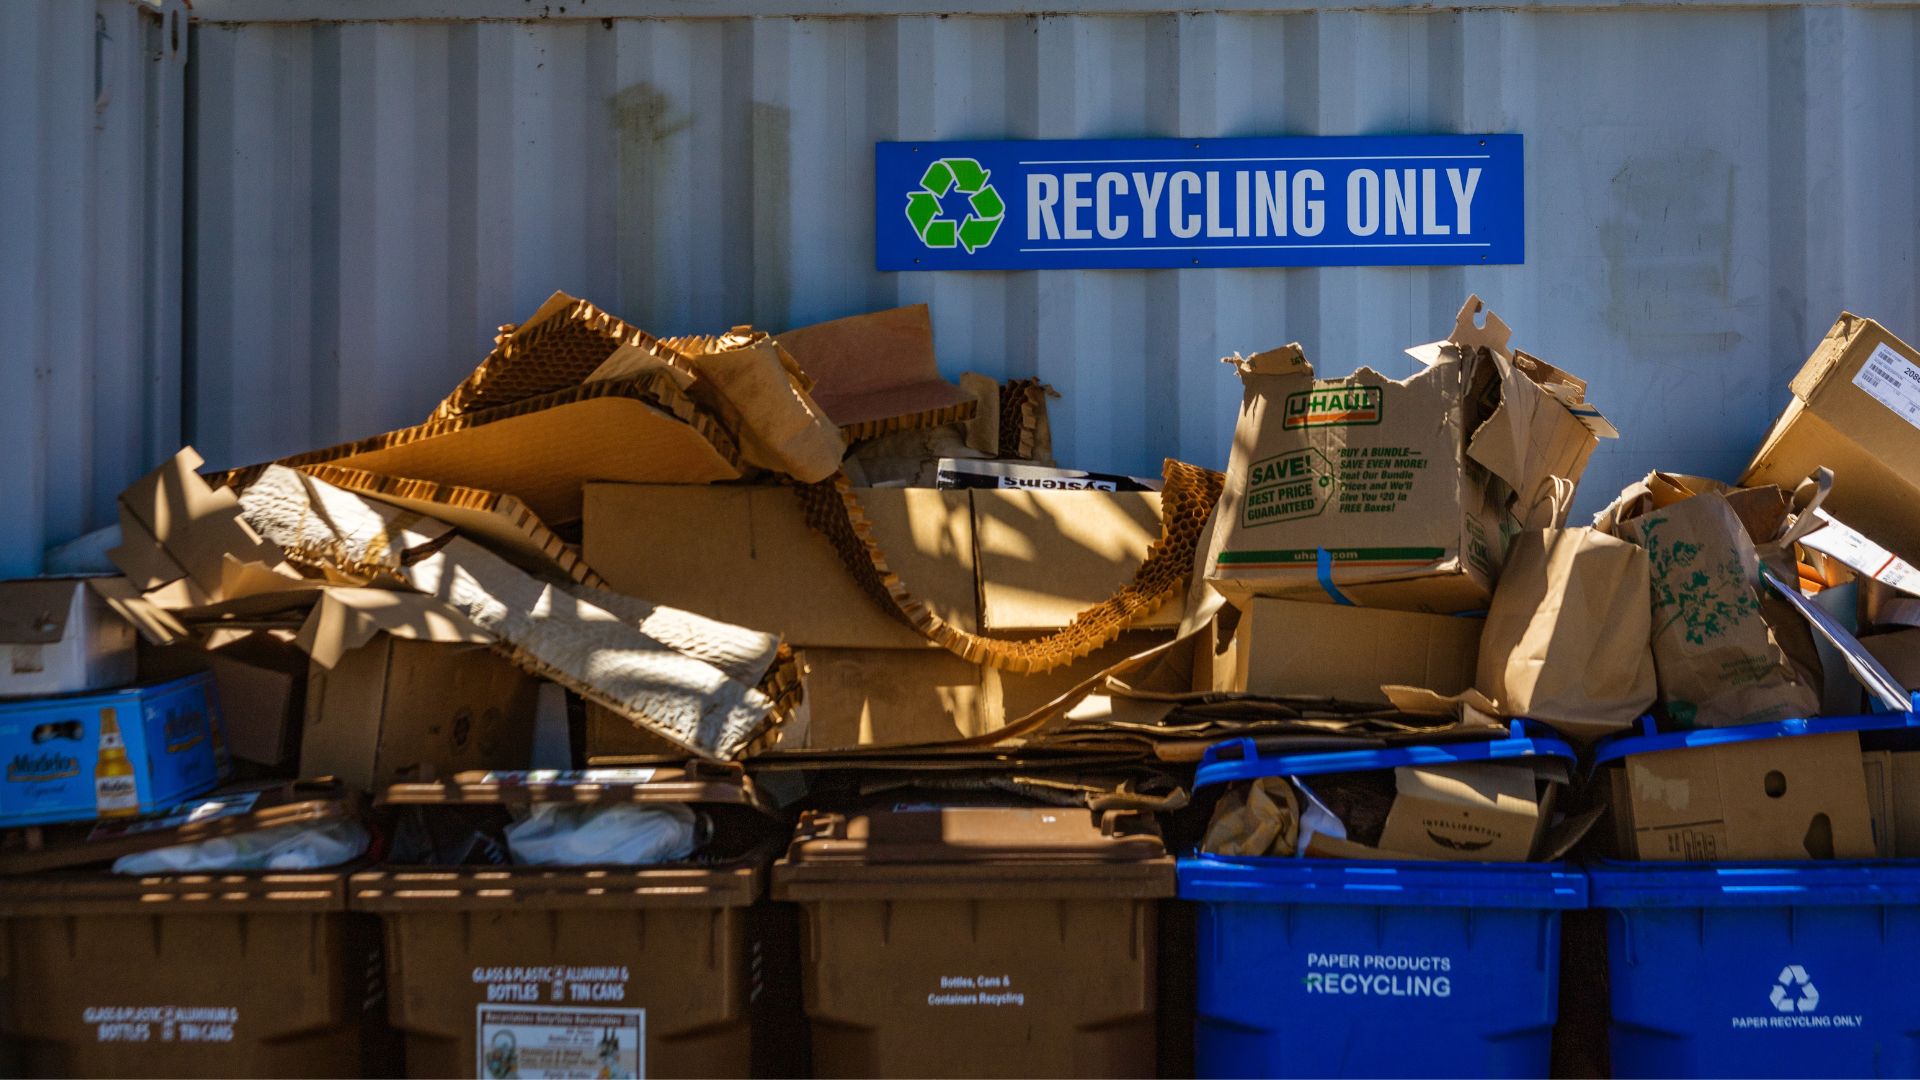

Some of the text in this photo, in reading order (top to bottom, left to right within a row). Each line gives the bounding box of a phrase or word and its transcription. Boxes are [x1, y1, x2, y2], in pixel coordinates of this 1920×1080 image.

[1026, 167, 1483, 240] RECYCLING ONLY
[1289, 393, 1376, 415] U-HAUL
[1360, 447, 1368, 457] A
[1250, 455, 1312, 486] SAVE!
[1340, 459, 1428, 469] SAVE EVEN MORE!
[1339, 470, 1414, 480] Beat Our Bundle
[1339, 481, 1413, 491] Prices and We'll
[1248, 484, 1312, 507] BEST PRICE
[1339, 493, 1359, 502] Give
[1361, 492, 1377, 501] You
[1339, 503, 1396, 513] FREE Boxes!
[1293, 551, 1359, 560] uhacom
[1307, 953, 1451, 971] PAPER PRODUCTS
[472, 967, 503, 982] GLASS
[513, 967, 552, 982] PLASTIC
[565, 967, 620, 982] ALUMINUM
[977, 974, 1001, 987] Cans
[487, 984, 539, 1000] BOTTLES
[569, 984, 625, 1000] TIN CANS
[1306, 972, 1451, 997] RECYCLING
[978, 991, 1025, 1007] Recycling
[1732, 1015, 1863, 1029] PAPER RECYCLING ONLY
